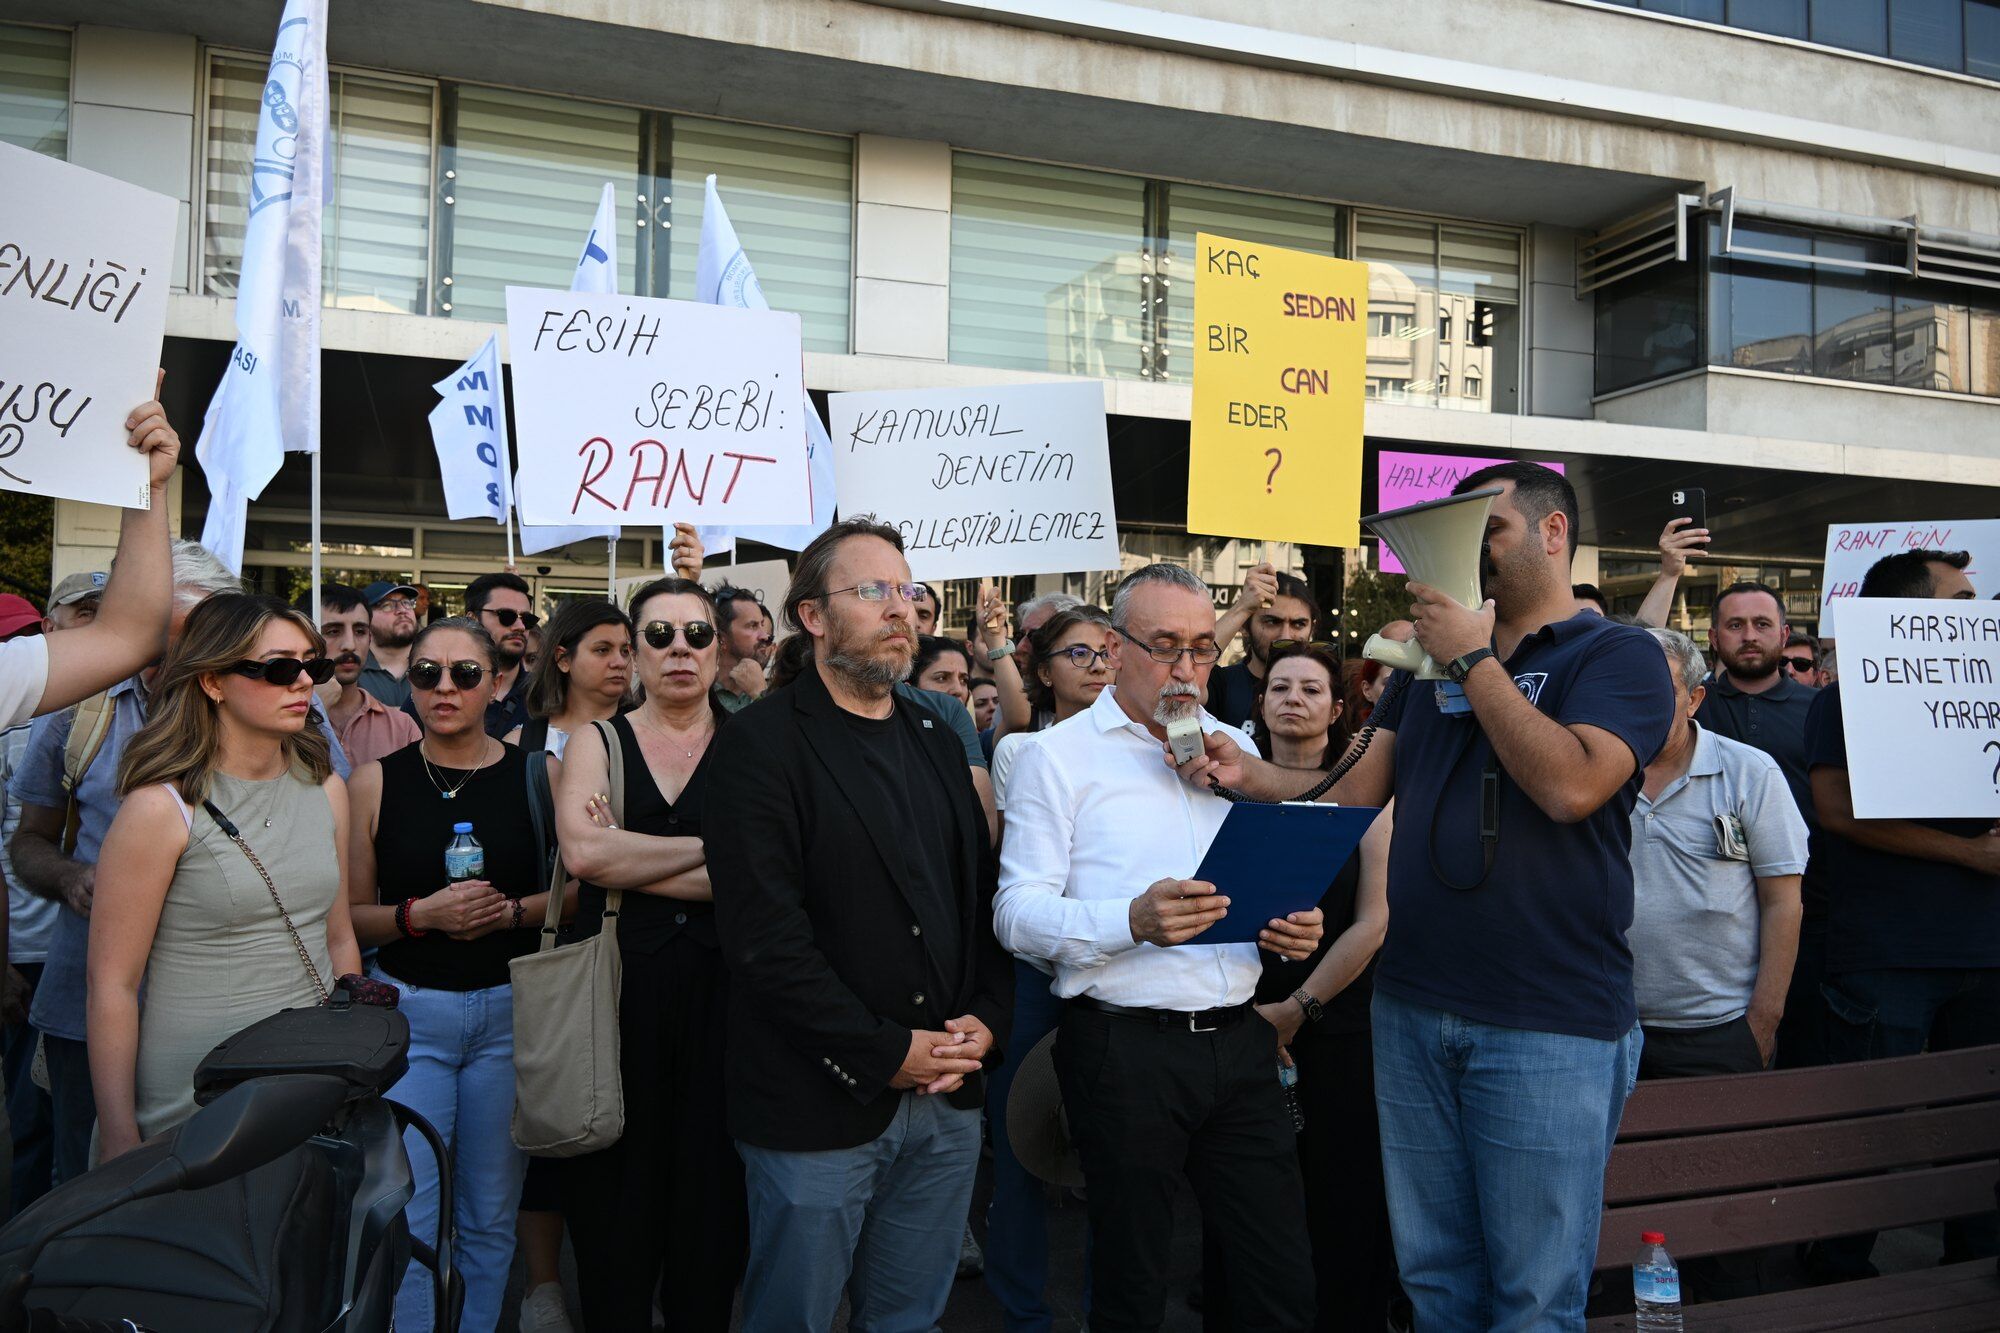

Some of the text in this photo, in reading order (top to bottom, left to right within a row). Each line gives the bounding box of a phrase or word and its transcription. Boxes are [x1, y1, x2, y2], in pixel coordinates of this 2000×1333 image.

[1207, 246, 1261, 279] KAÇ
[1283, 292, 1356, 322] SEDAN
[534, 306, 661, 357] FESİH
[1208, 323, 1250, 355] BİR
[1280, 367, 1329, 396] CAN
[634, 373, 786, 433] SEBEBİ:
[1227, 402, 1289, 431] EDER
[849, 404, 1024, 453] KAMUSAL
[571, 437, 777, 515] RANT
[931, 442, 1074, 490] DENETİM
[1264, 447, 1283, 494] ?
[868, 508, 1106, 552] ELLEŞTİRİLEMEZ
[1833, 525, 1952, 553] RANT İÇİN
[1890, 614, 2000, 643] KARŞIYA
[1862, 652, 1993, 684] DENETİM
